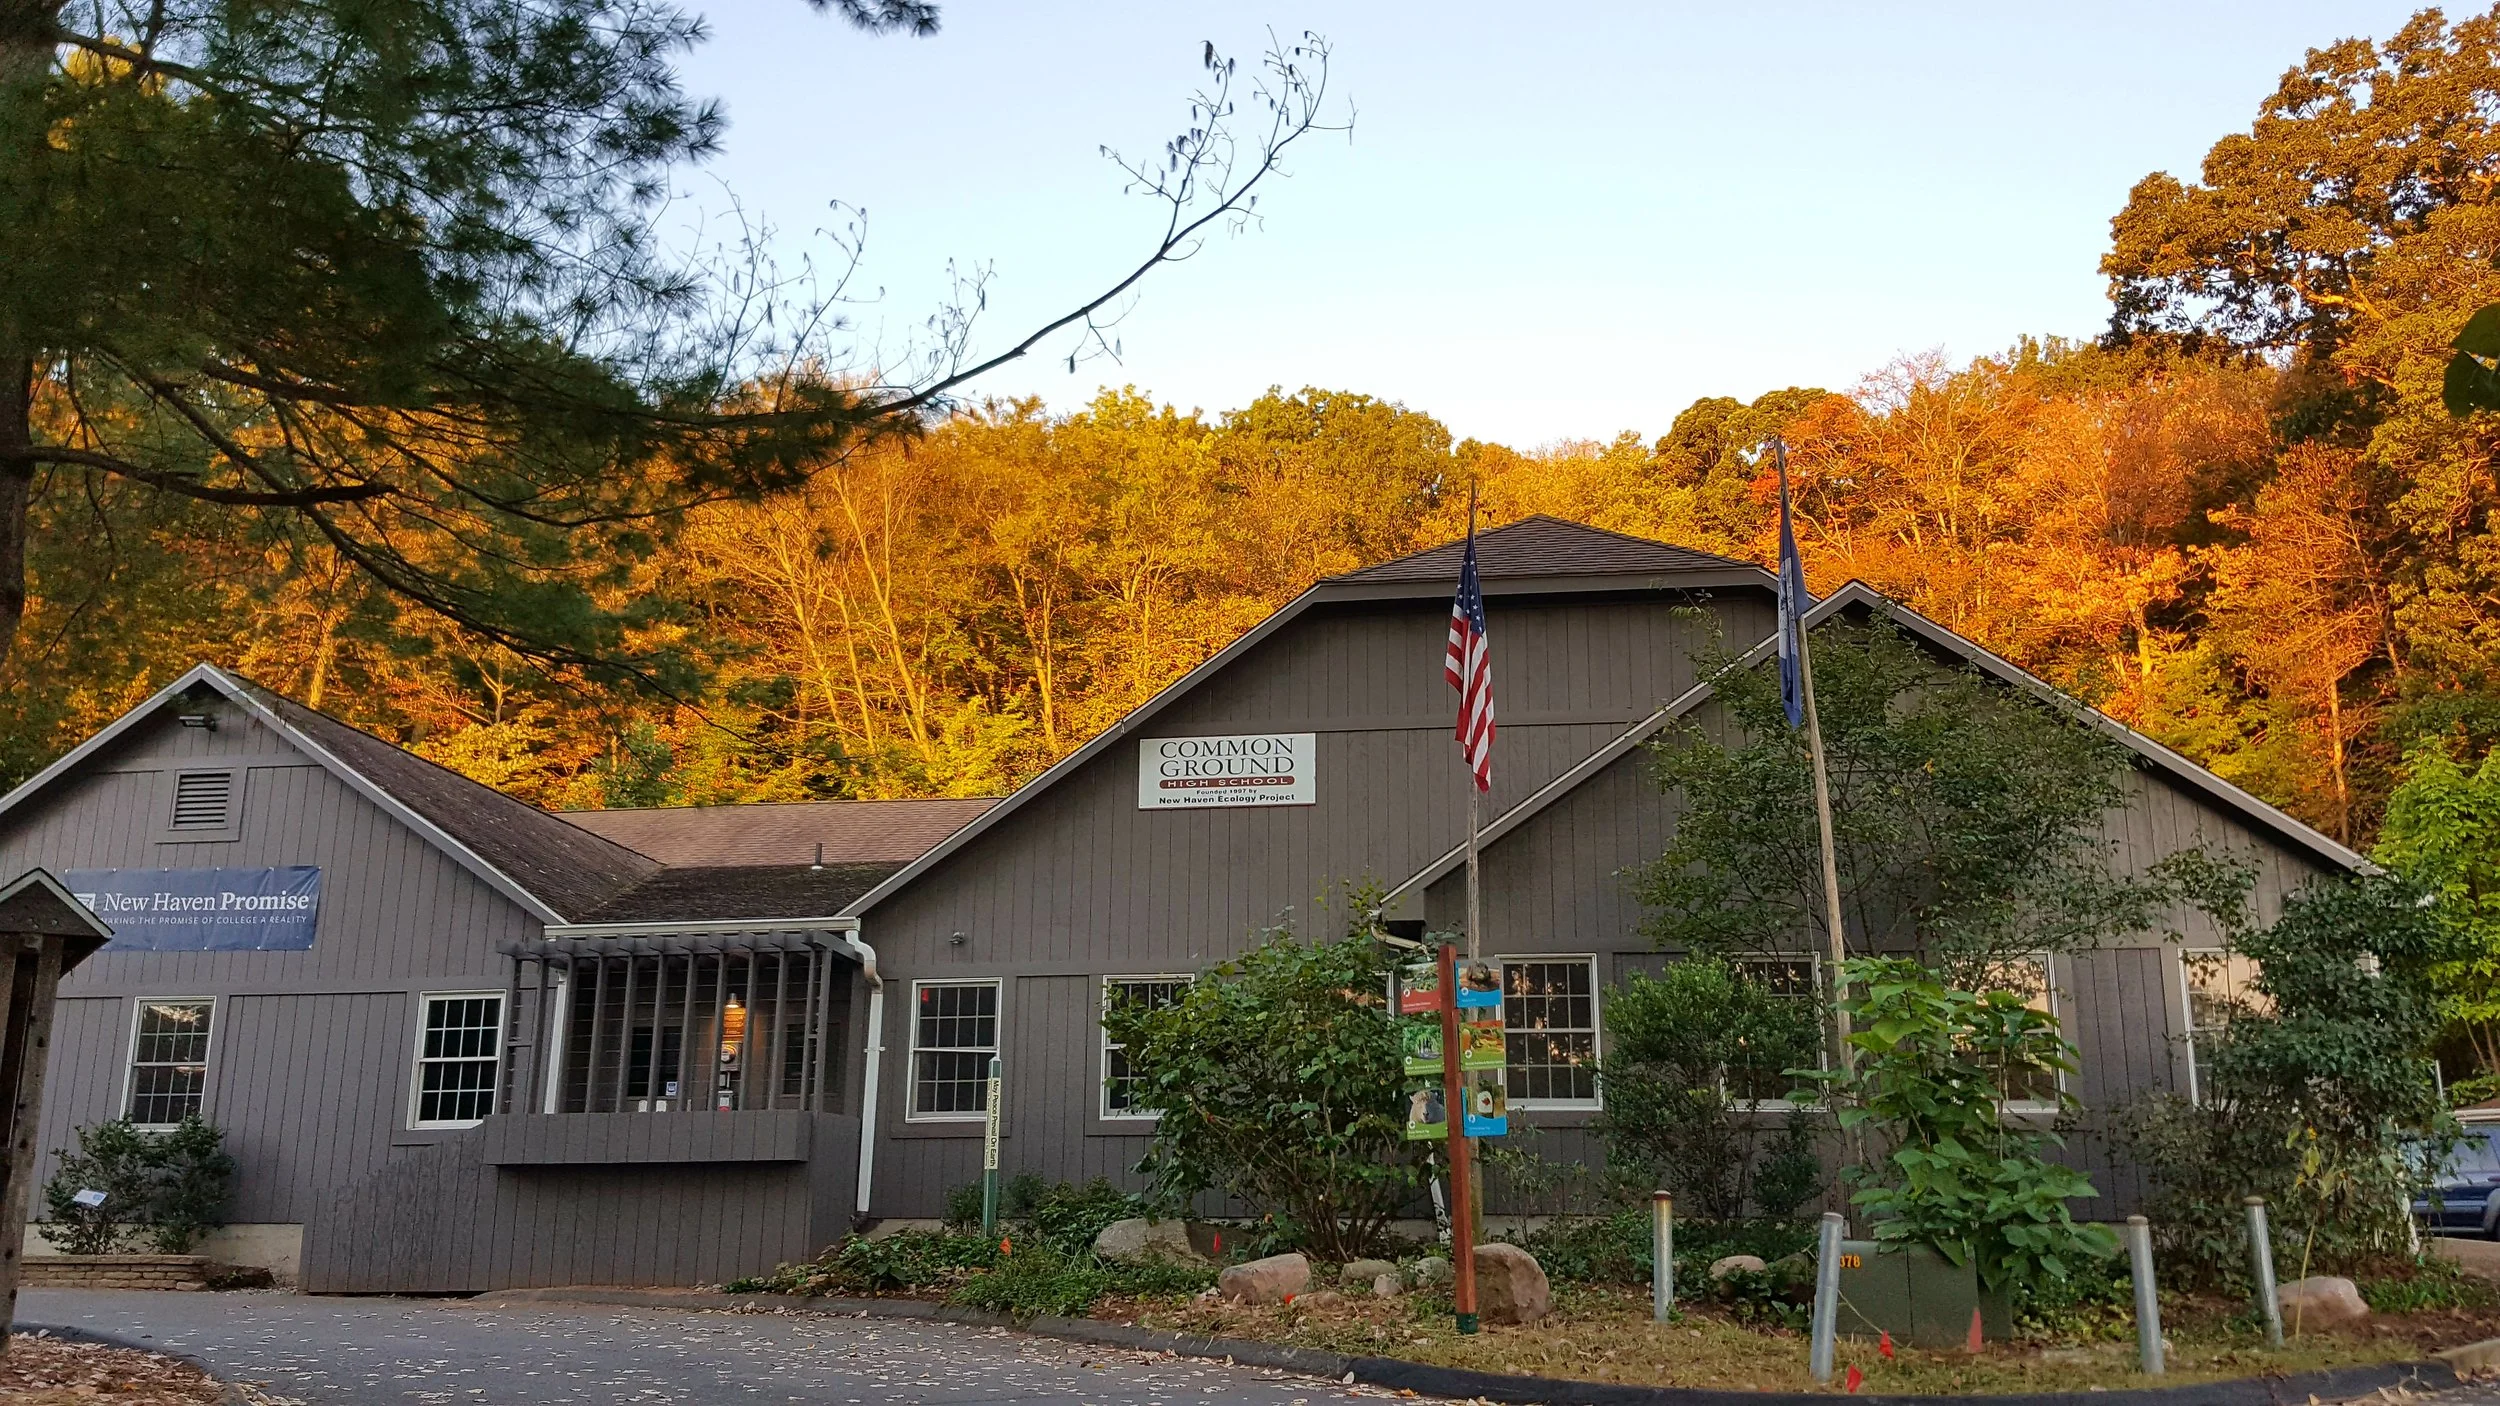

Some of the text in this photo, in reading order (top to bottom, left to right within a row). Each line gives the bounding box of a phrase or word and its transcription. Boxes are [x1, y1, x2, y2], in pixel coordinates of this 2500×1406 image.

[1160, 738, 1295, 759] COMMON
[1160, 756, 1295, 777] GROUND
[1167, 778, 1288, 788] HIGH SCHOOL
[1183, 796, 1215, 804] Haven
[1217, 795, 1257, 804] Ecology
[1259, 793, 1296, 803] Project
[103, 890, 310, 912] New Haven Promise
[138, 916, 157, 925] THE
[159, 916, 199, 925] PROMISE
[201, 916, 214, 925] OF
[216, 915, 258, 925] COLLEGE
[260, 915, 267, 924] A
[269, 915, 308, 924] REALITY
[991, 1138, 997, 1147] On
